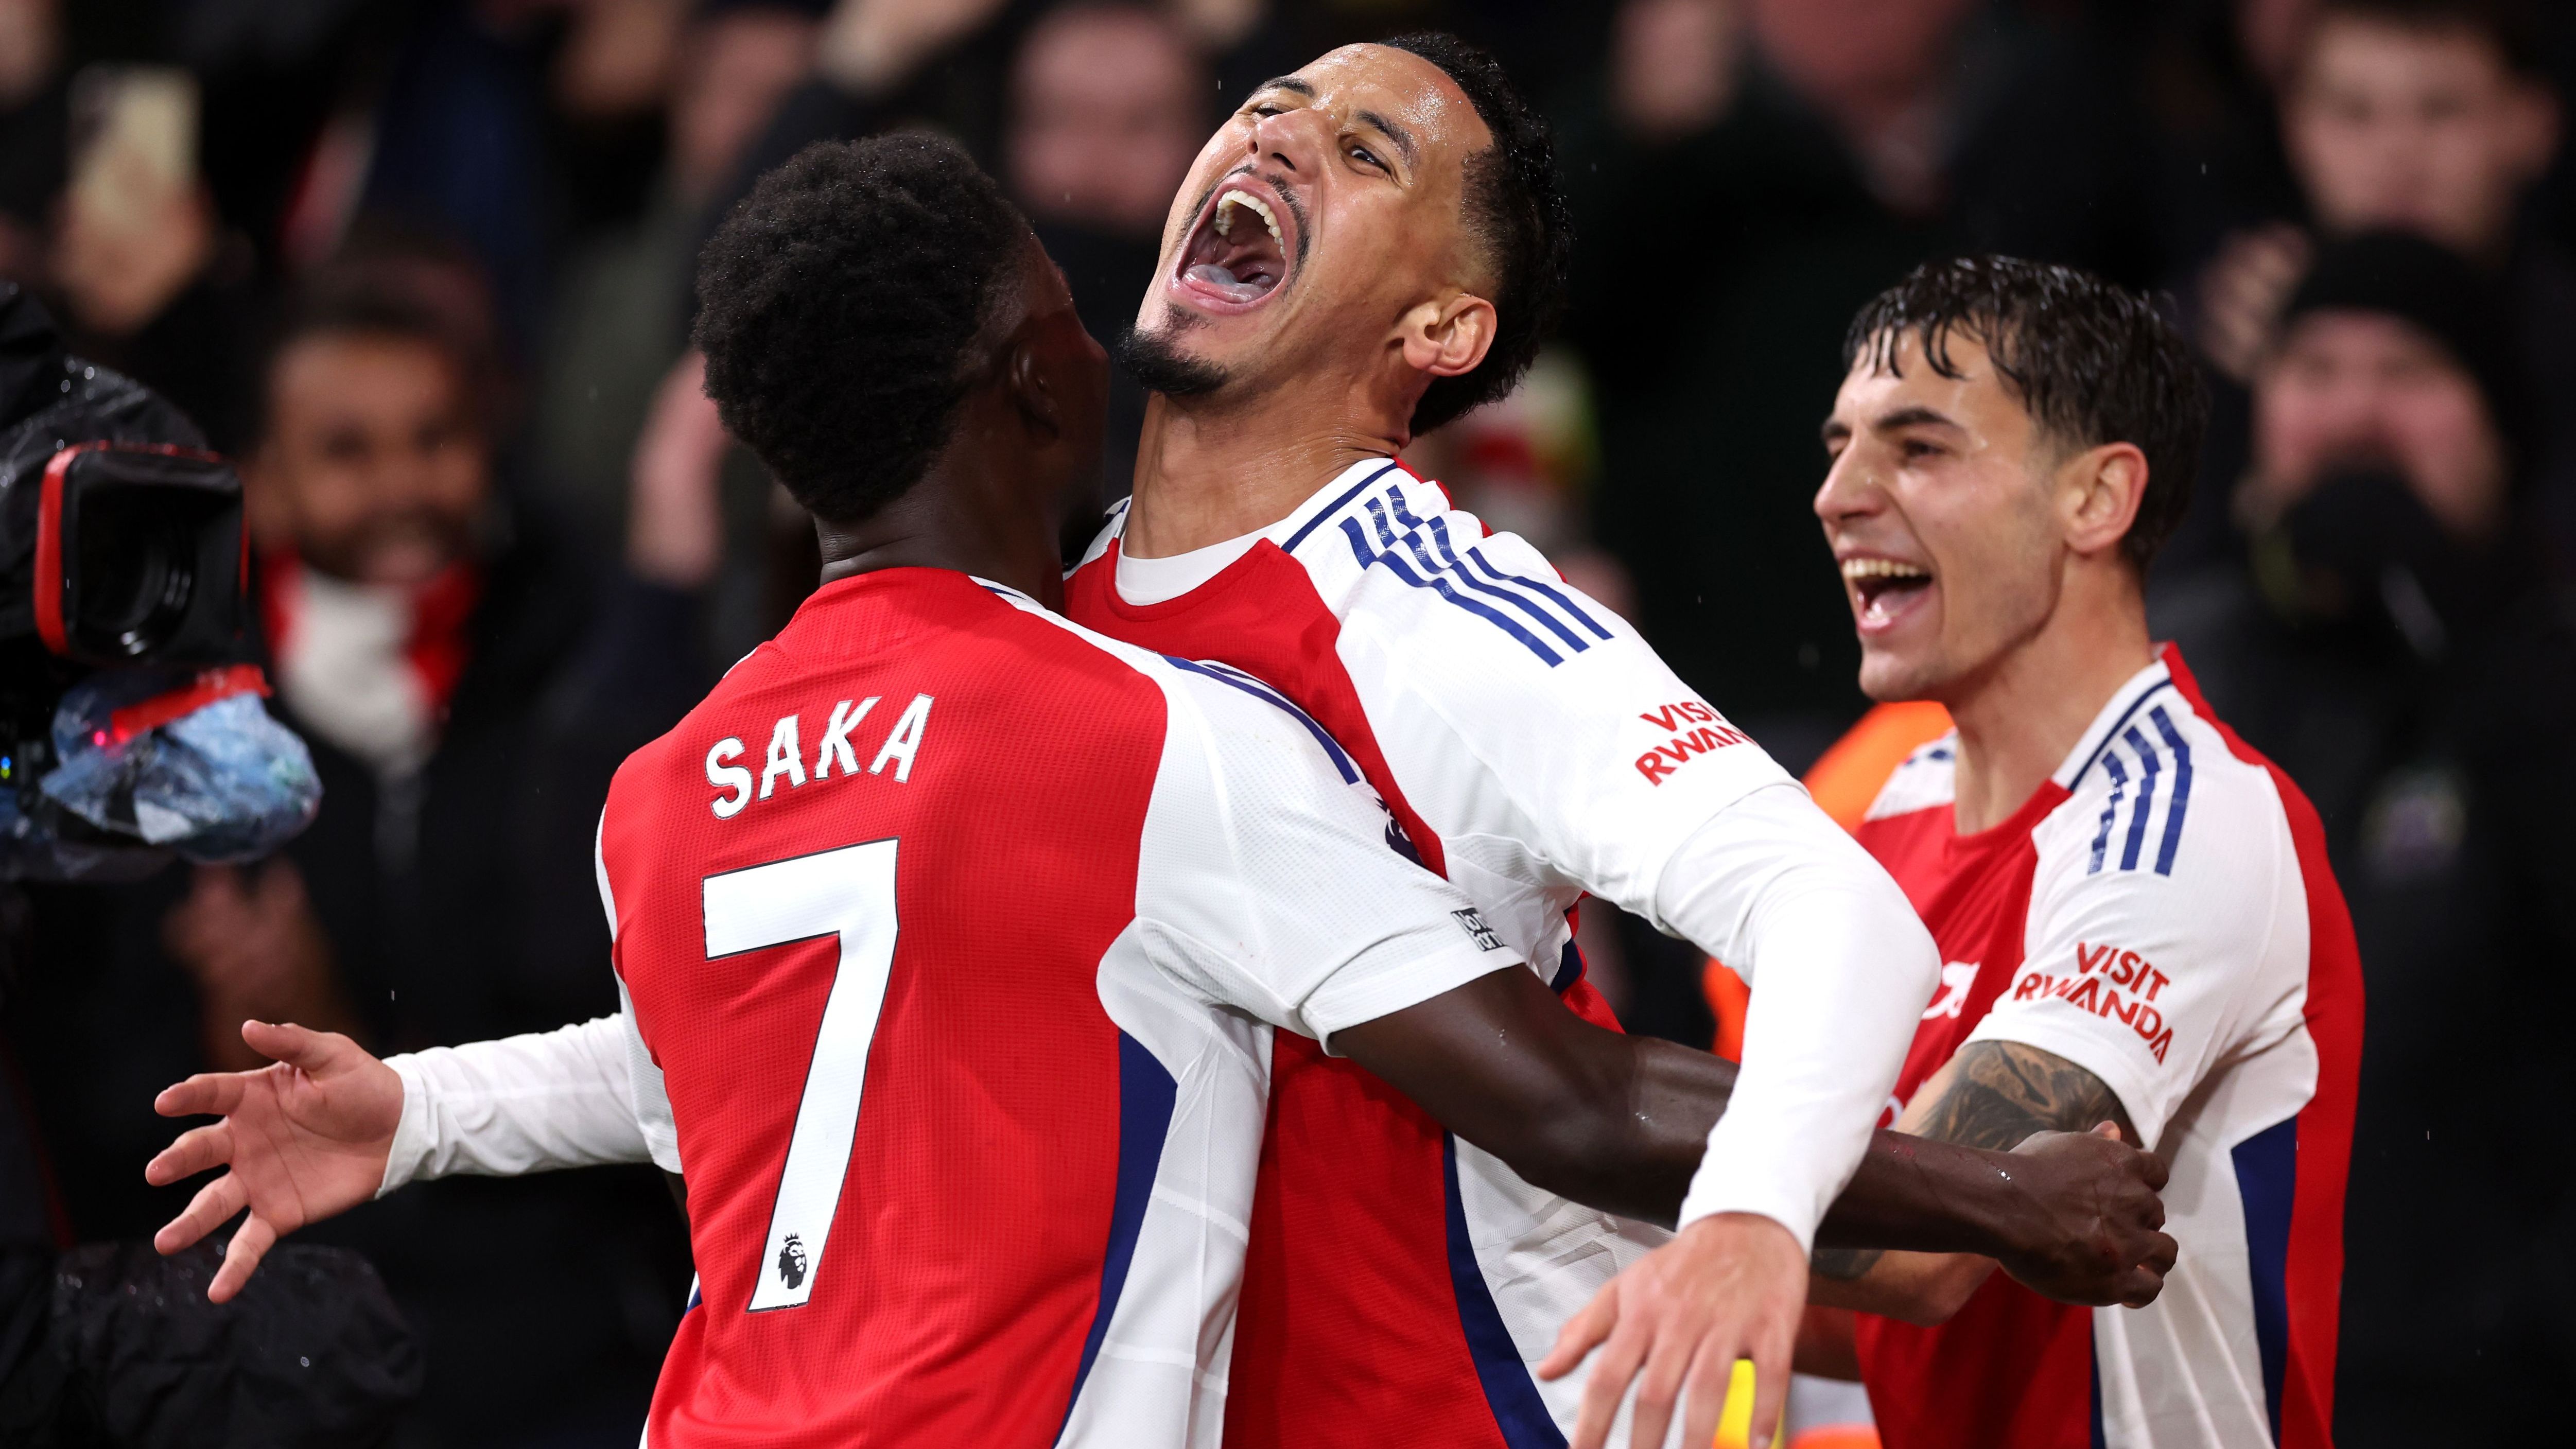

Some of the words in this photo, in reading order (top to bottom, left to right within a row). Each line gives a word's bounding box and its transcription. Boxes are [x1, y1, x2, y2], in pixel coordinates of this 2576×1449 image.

[705, 693, 935, 819] SAKA
[2013, 972, 2173, 1066] RWANDA
[2077, 942, 2169, 1002] VISIT
[702, 836, 900, 1313] 7
